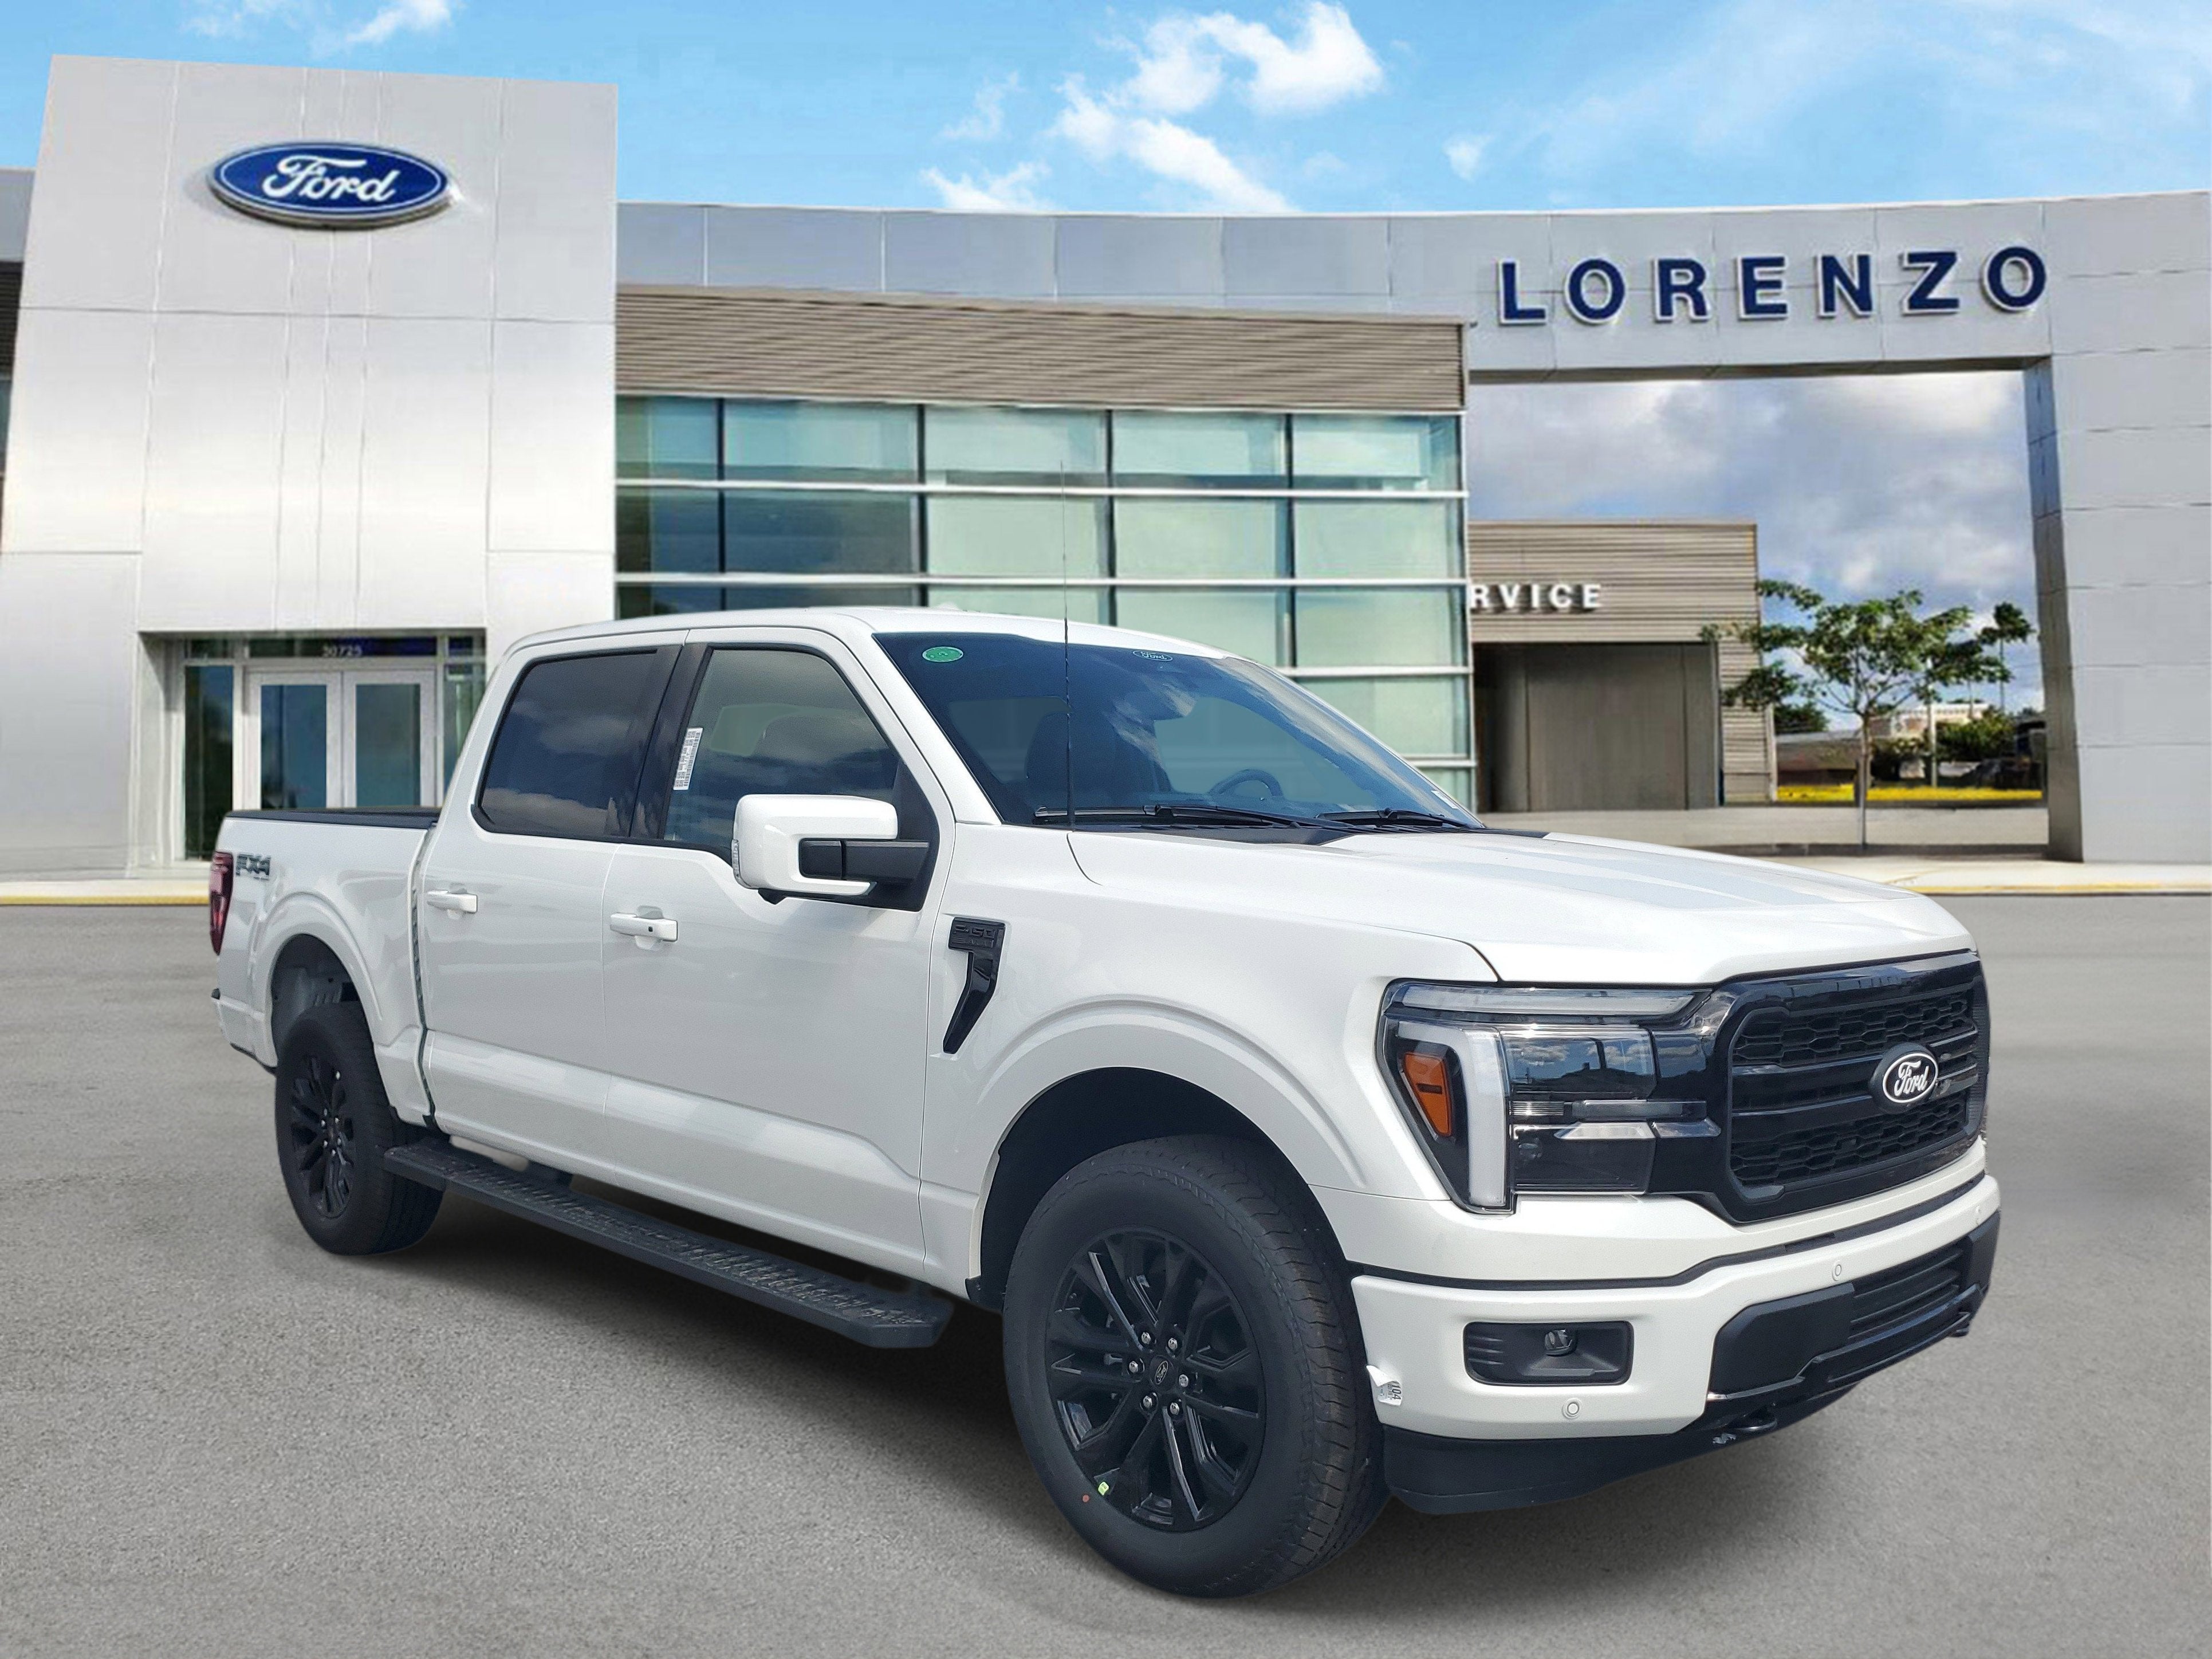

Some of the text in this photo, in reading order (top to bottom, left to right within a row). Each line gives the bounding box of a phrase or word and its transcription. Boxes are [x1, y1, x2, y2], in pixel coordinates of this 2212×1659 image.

[262, 155, 400, 202] Ford
[1497, 246, 2047, 325] LORENZO
[1470, 583, 1602, 609] RVICE
[1894, 1060, 1930, 1096] Ford
